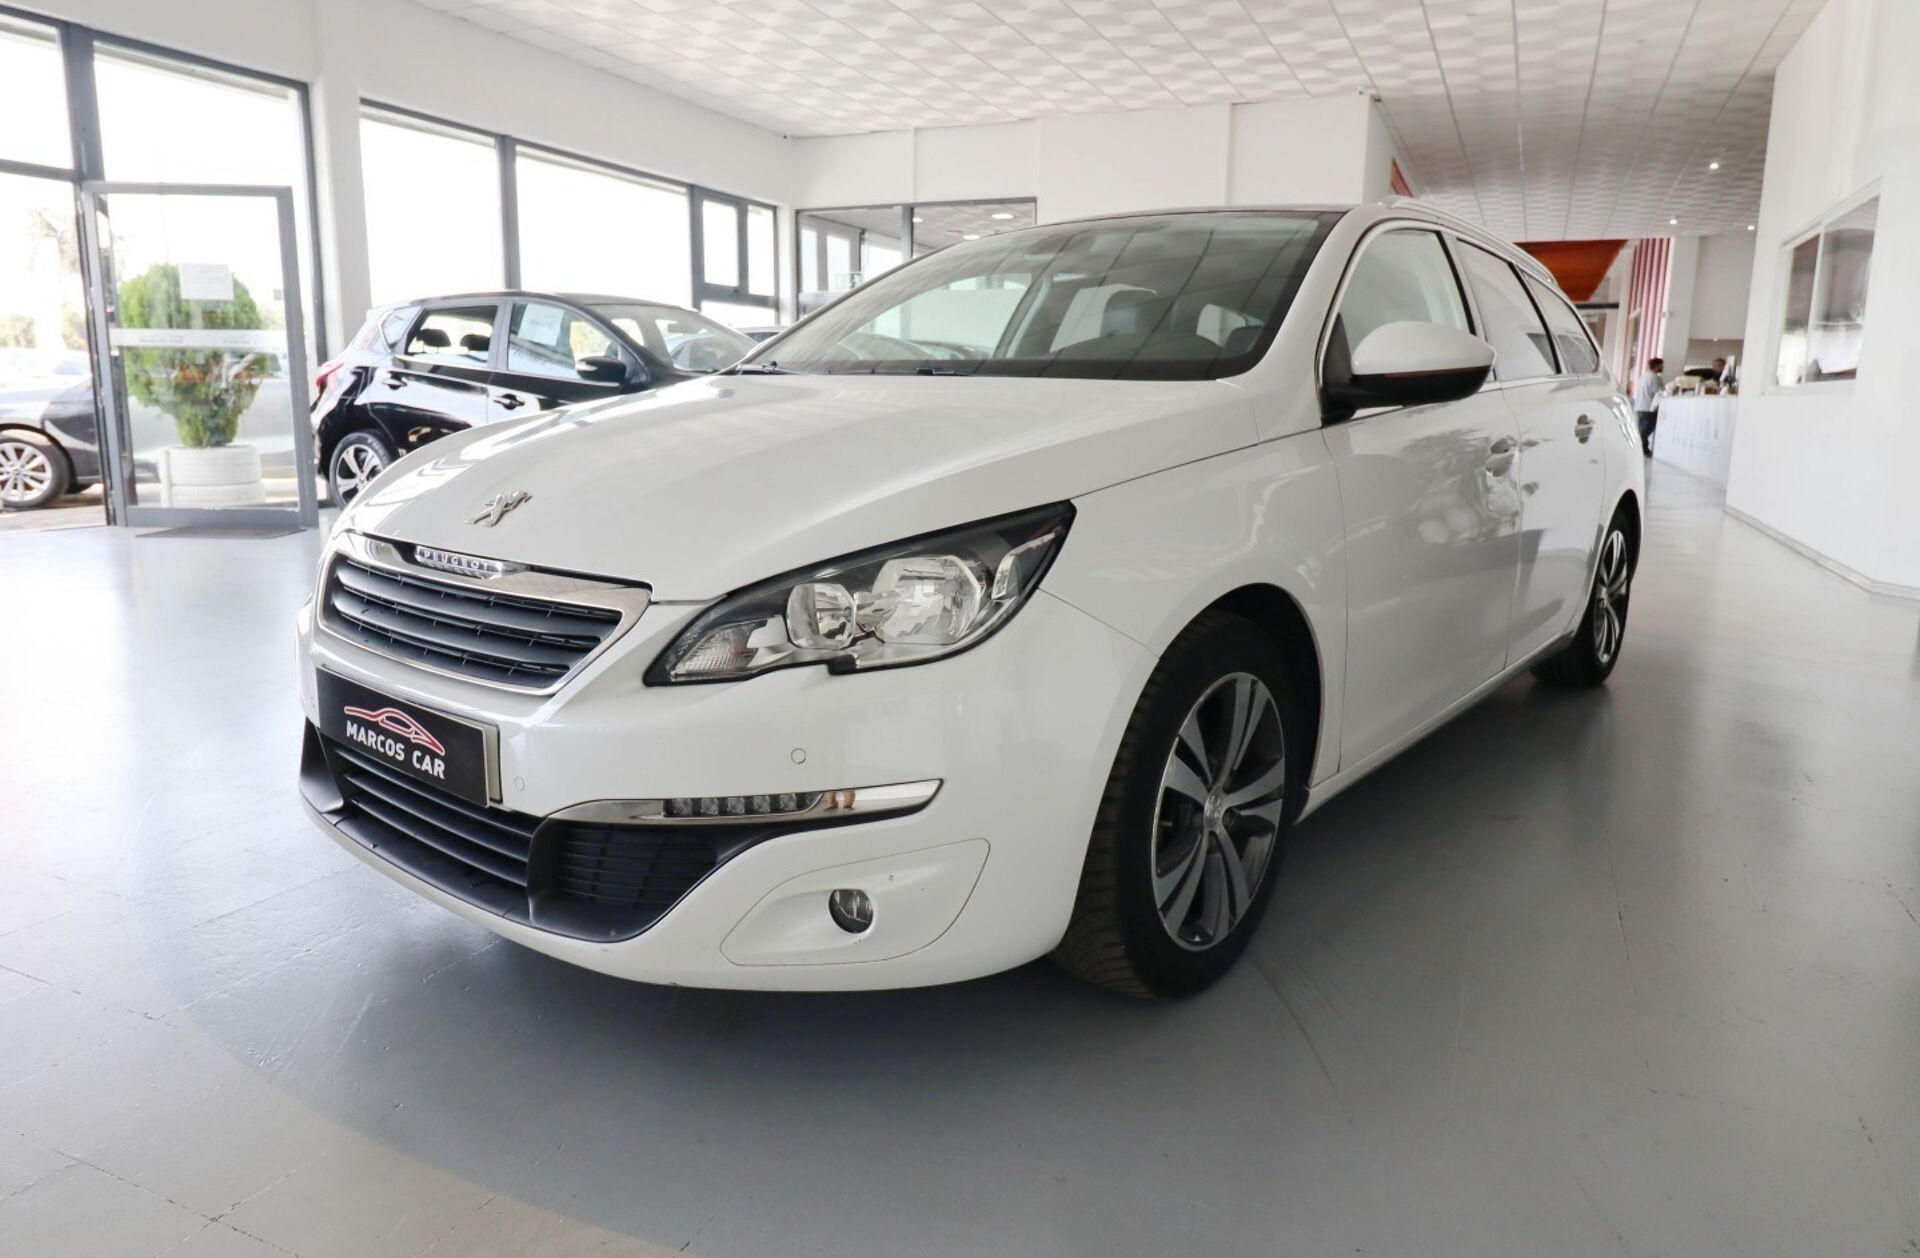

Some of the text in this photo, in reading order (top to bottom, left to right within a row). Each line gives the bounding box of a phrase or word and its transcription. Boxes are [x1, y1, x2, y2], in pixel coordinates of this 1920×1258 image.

[423, 549, 489, 572] PEUGEOT
[346, 720, 446, 779] MARCOS CAR
